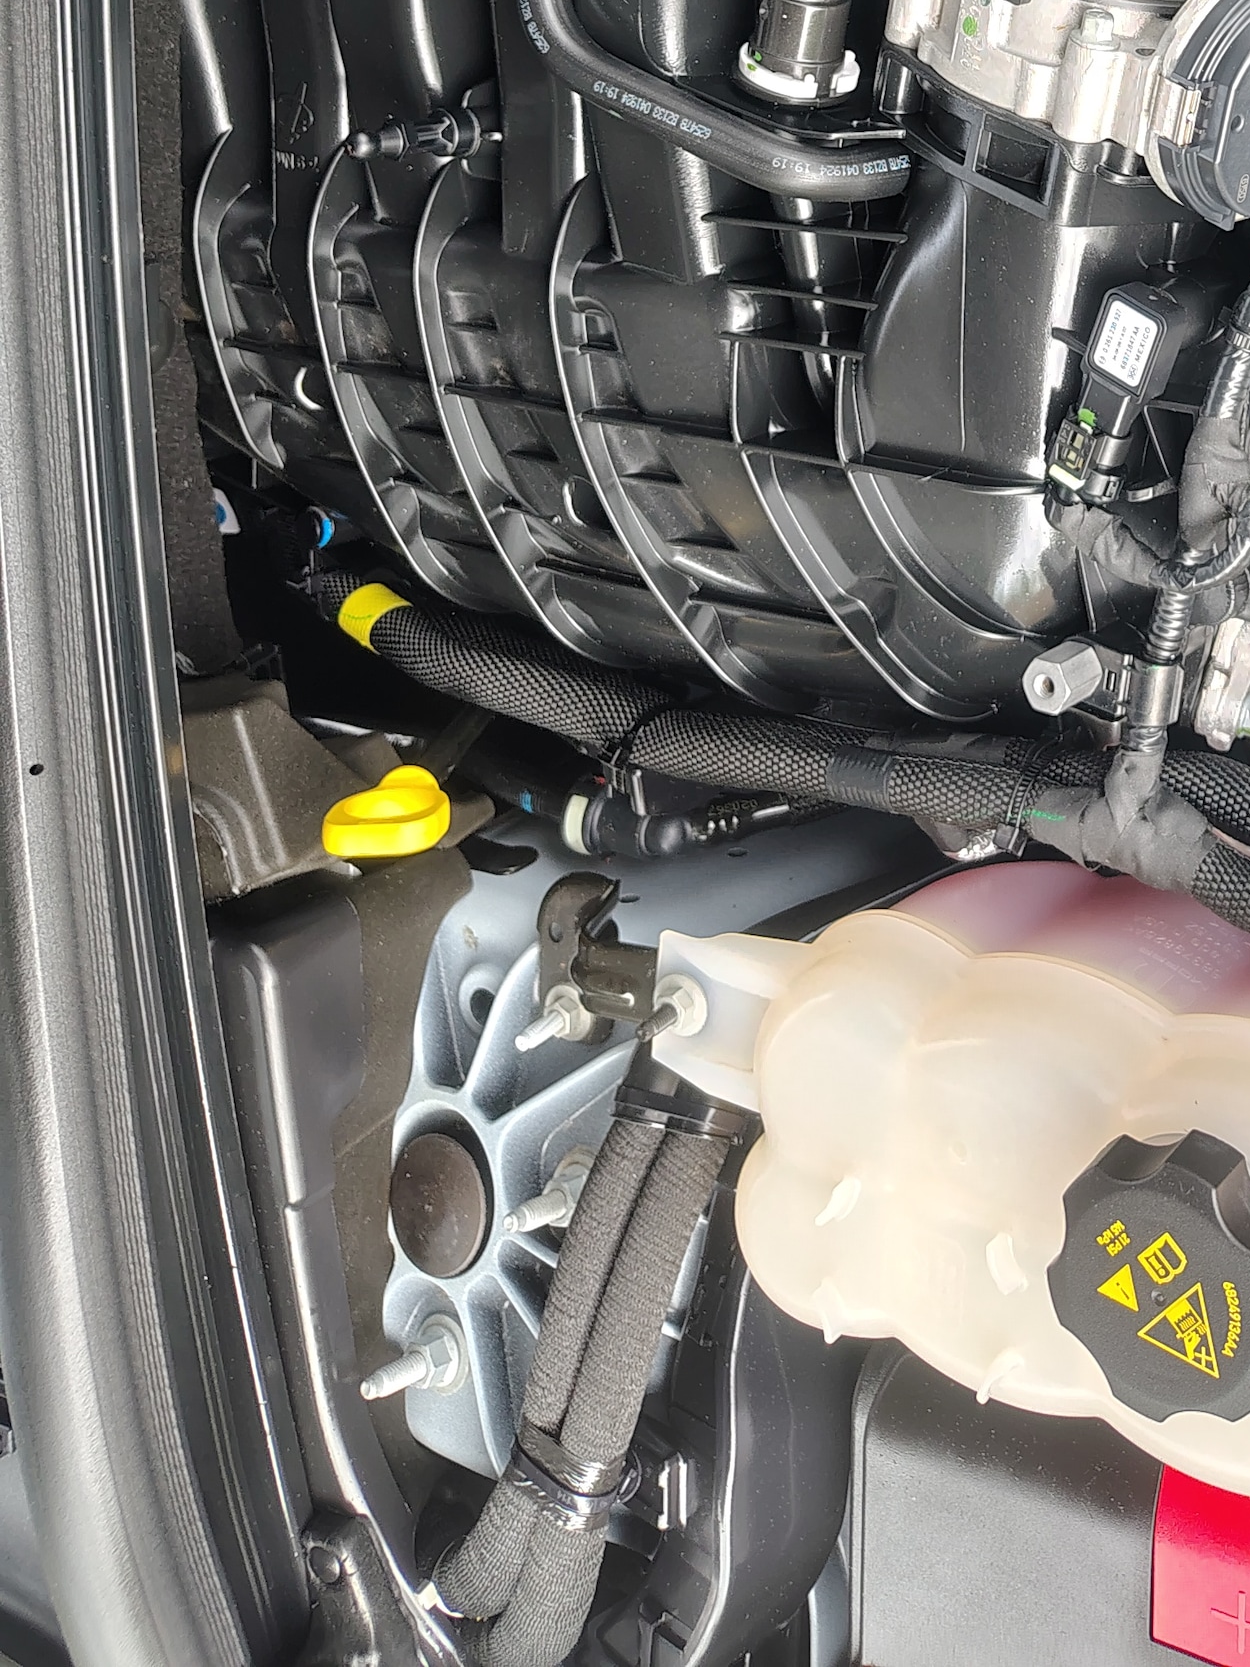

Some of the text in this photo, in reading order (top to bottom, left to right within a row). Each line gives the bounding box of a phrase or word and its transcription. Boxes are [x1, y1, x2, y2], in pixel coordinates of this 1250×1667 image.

[593, 80, 619, 99] 19:19
[621, 92, 652, 114] 041924
[772, 157, 811, 174] 19:19
[819, 164, 860, 176] 041924
[1134, 326, 1151, 363] MEXICO
[1106, 1240, 1123, 1257] PSI
[1221, 1281, 1242, 1358] 68249136AA
